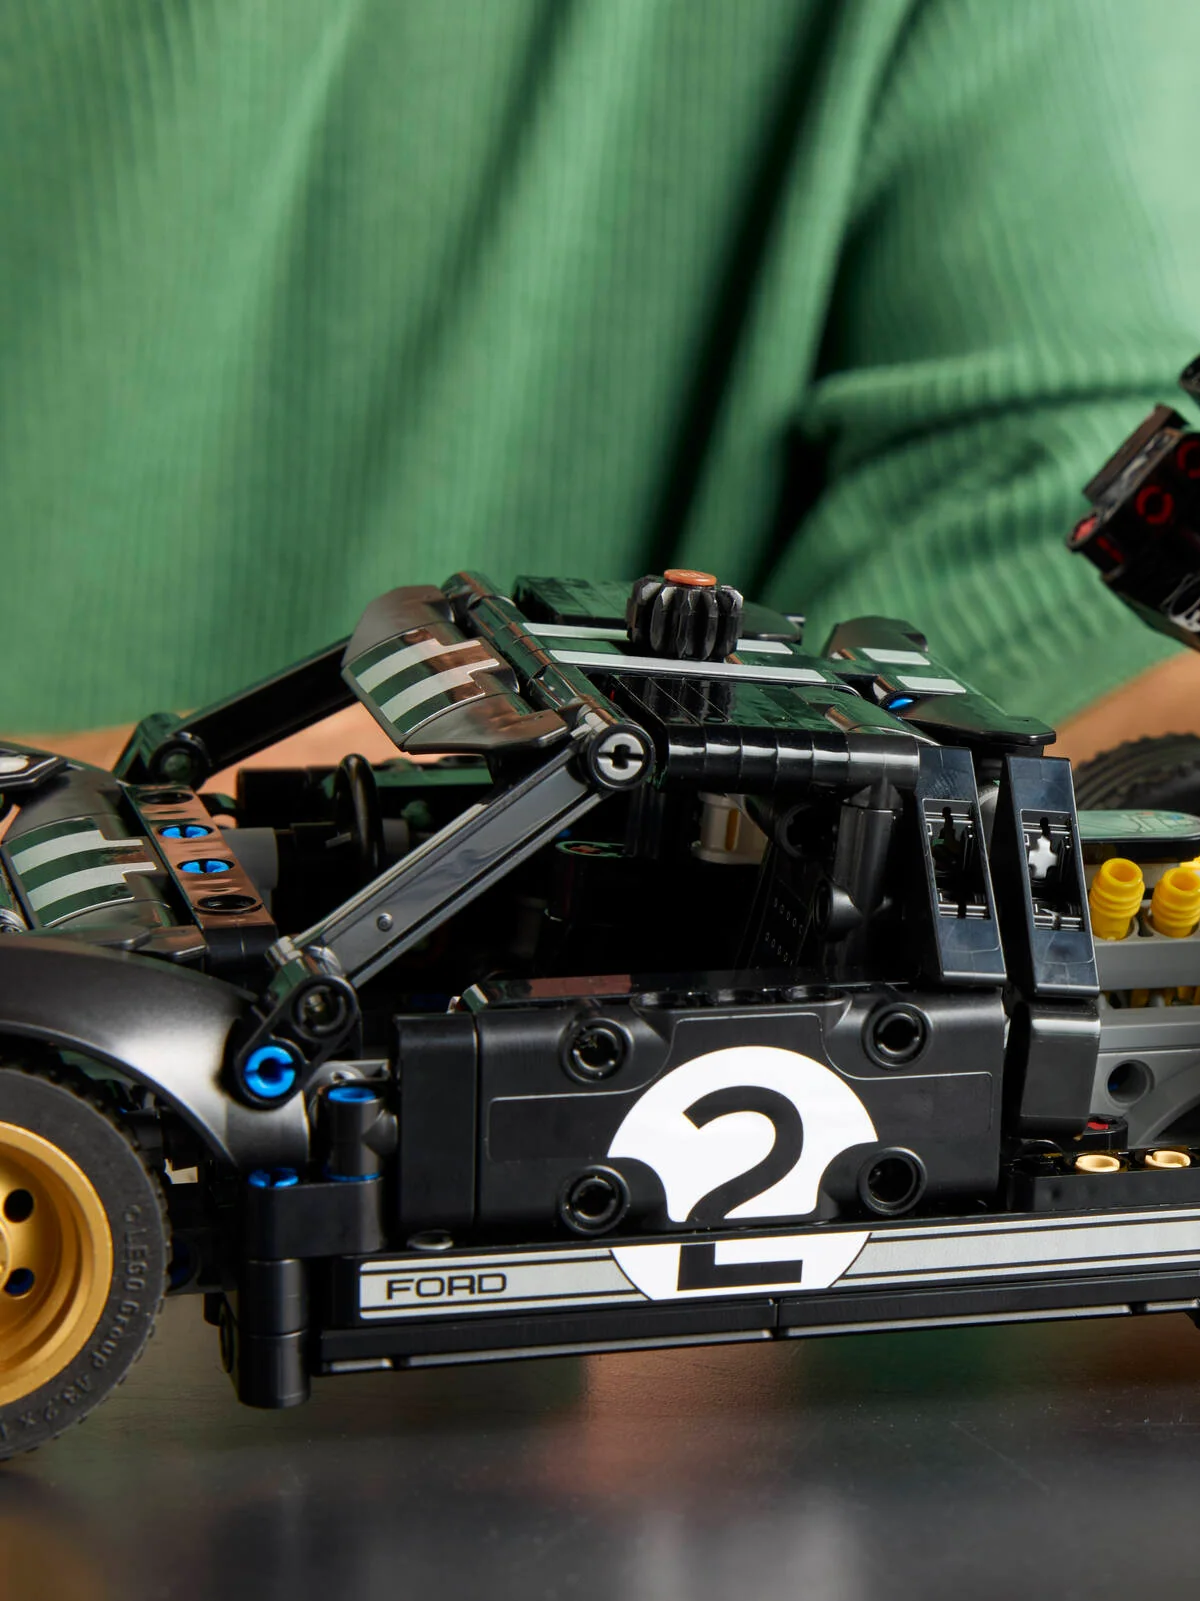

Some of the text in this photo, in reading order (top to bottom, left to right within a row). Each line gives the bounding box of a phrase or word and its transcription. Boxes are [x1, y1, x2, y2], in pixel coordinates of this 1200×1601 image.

[678, 1085, 804, 1291] 2
[386, 1272, 508, 1301] FORD
[91, 1300, 140, 1368] Group
